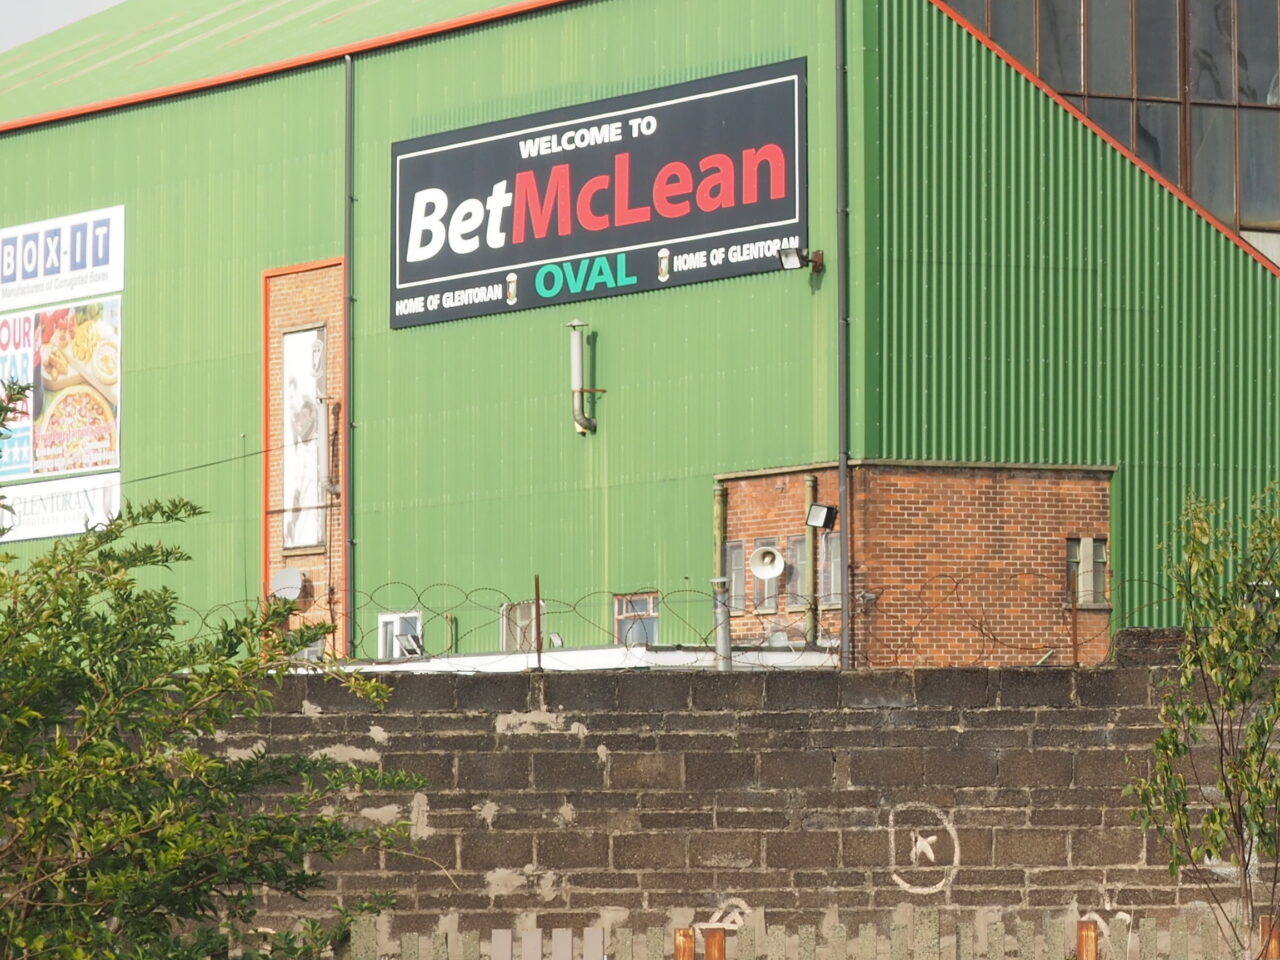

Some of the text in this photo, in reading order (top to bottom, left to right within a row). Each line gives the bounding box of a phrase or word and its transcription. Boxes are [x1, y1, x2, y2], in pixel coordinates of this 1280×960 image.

[519, 115, 657, 158] WELCOME TO
[406, 143, 786, 263] BetMcLean
[3, 226, 108, 277] BOX-IT
[673, 236, 799, 272] HOME OF GLENTORAN
[46, 279, 53, 291] of
[534, 253, 638, 299] OVAL
[395, 284, 502, 316] HOME OF GLENTORAN
[11, 487, 96, 527] GLENTORAN
